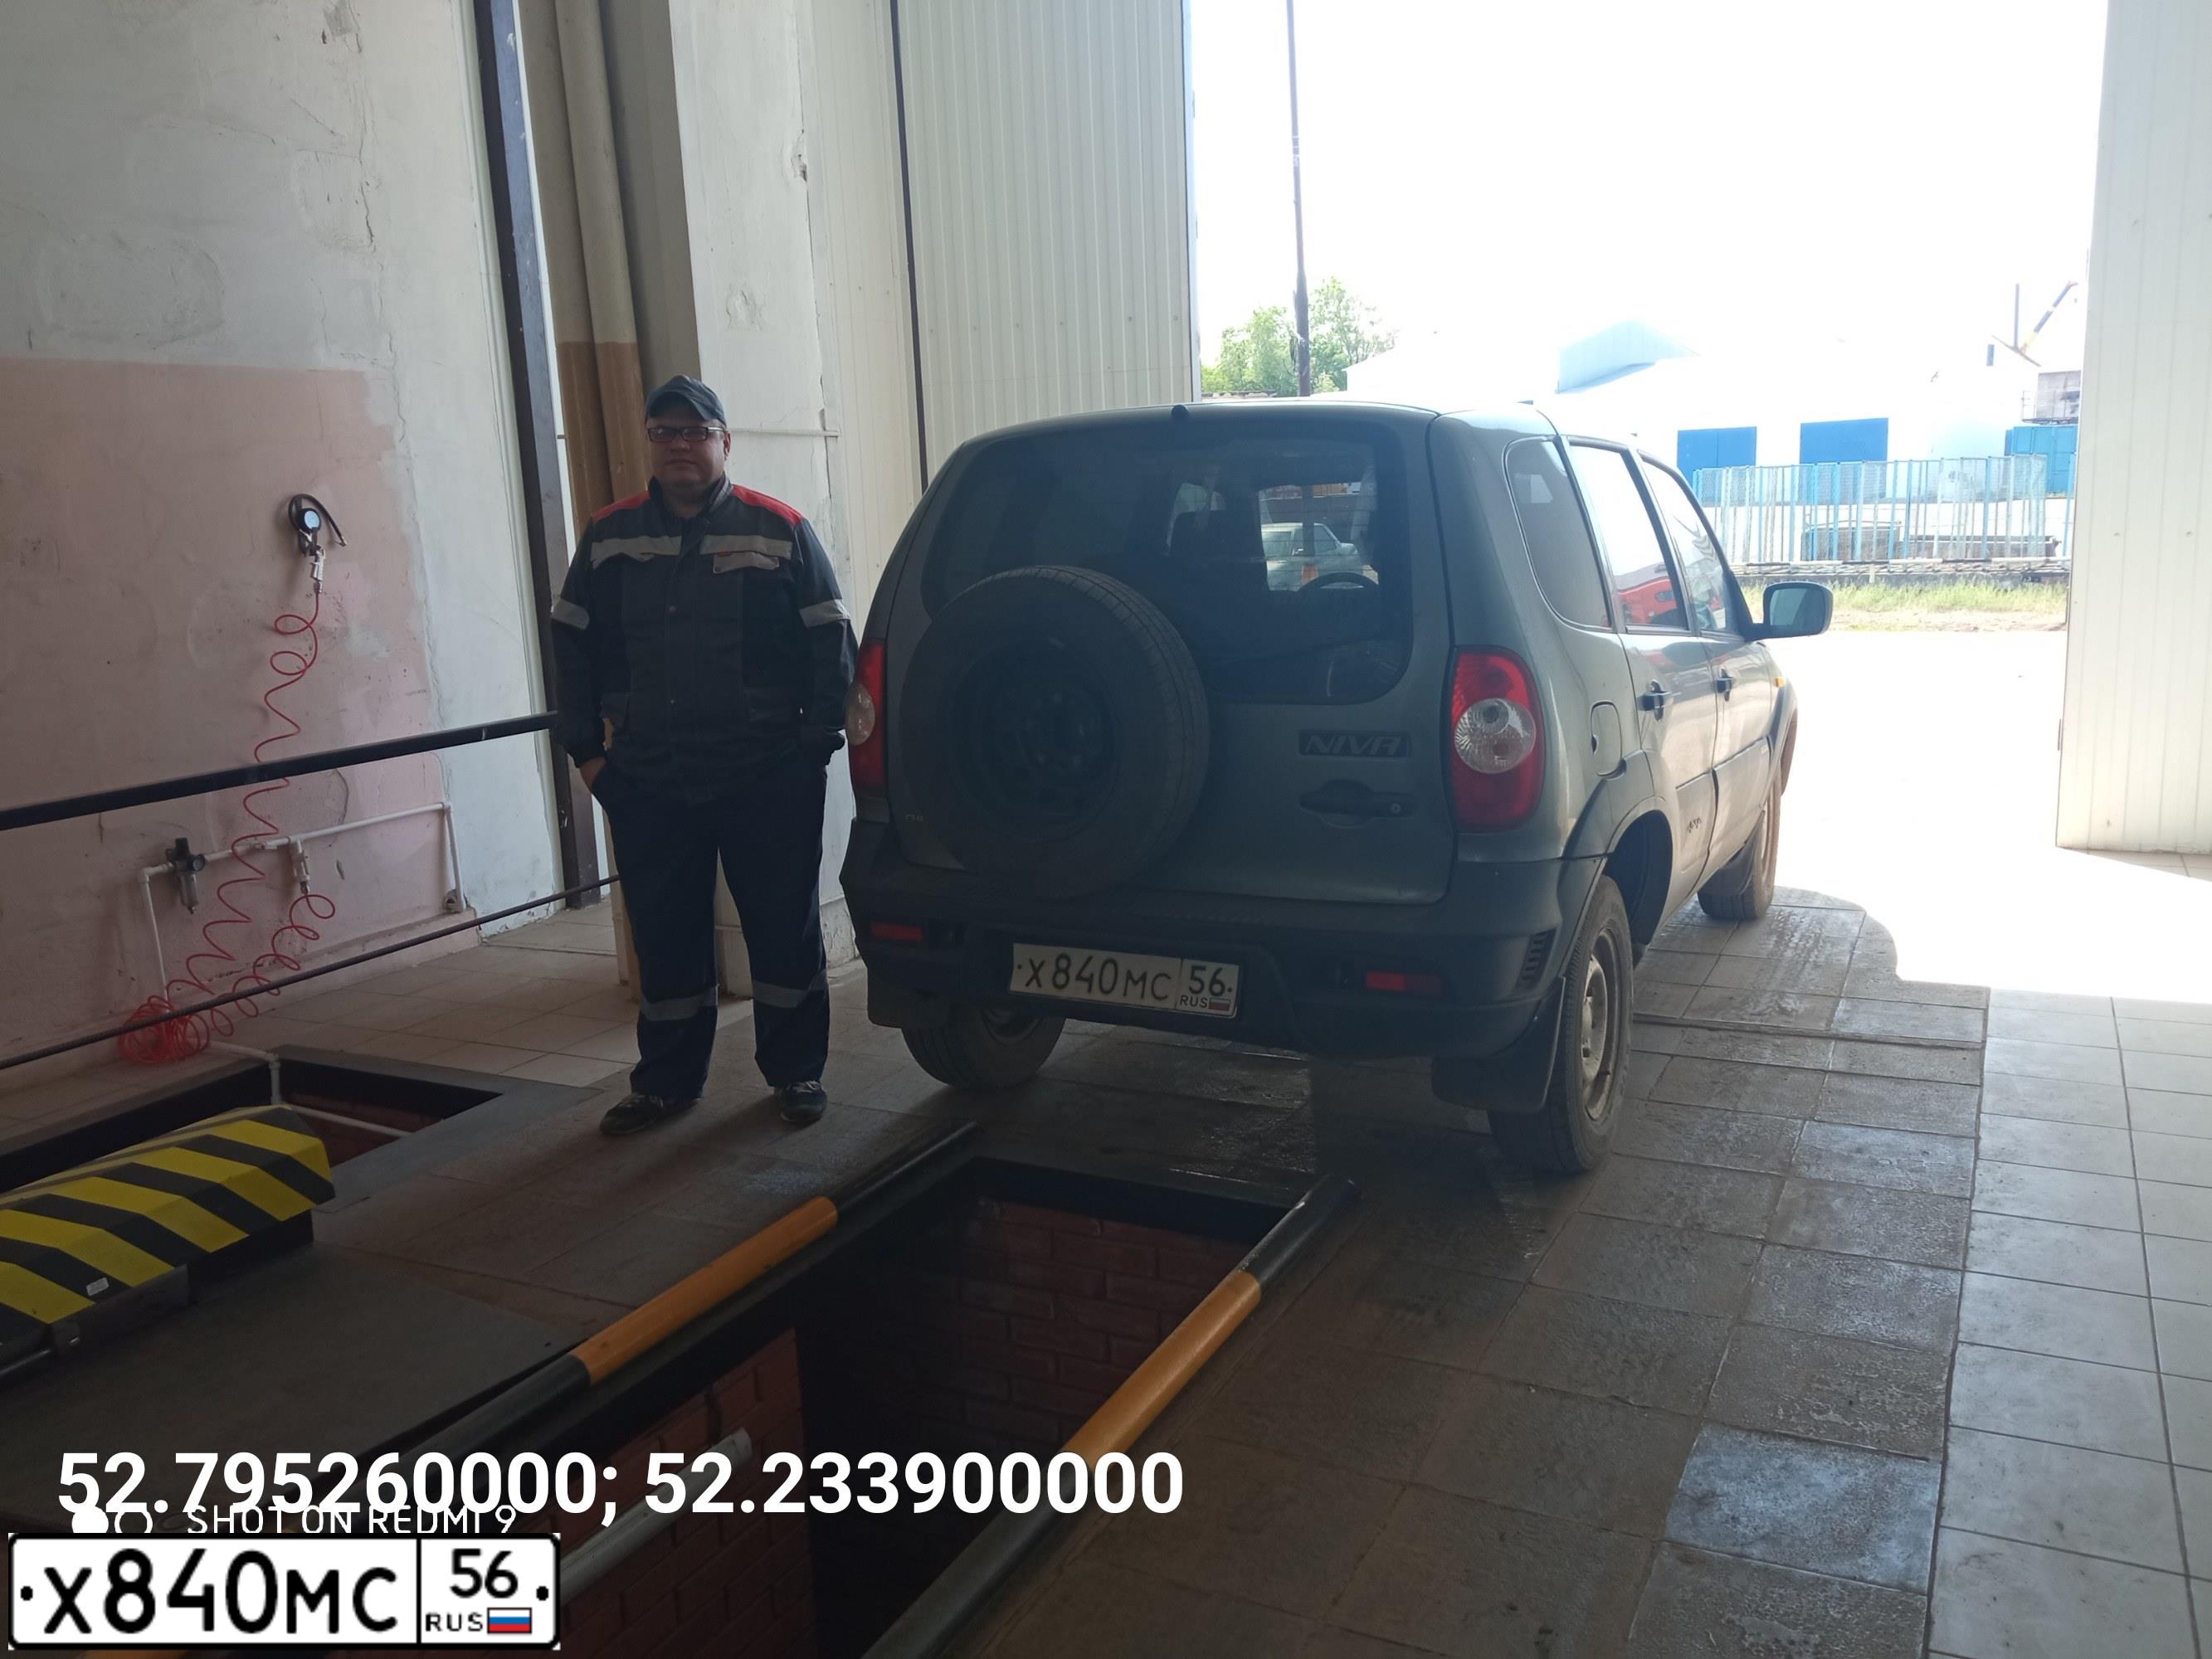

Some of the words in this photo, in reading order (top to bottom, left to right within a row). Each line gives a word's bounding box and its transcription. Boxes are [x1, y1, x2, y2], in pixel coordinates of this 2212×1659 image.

[1305, 735, 1401, 756] NIVA
[1189, 965, 1225, 997] 56
[1179, 995, 1208, 1009] RUS
